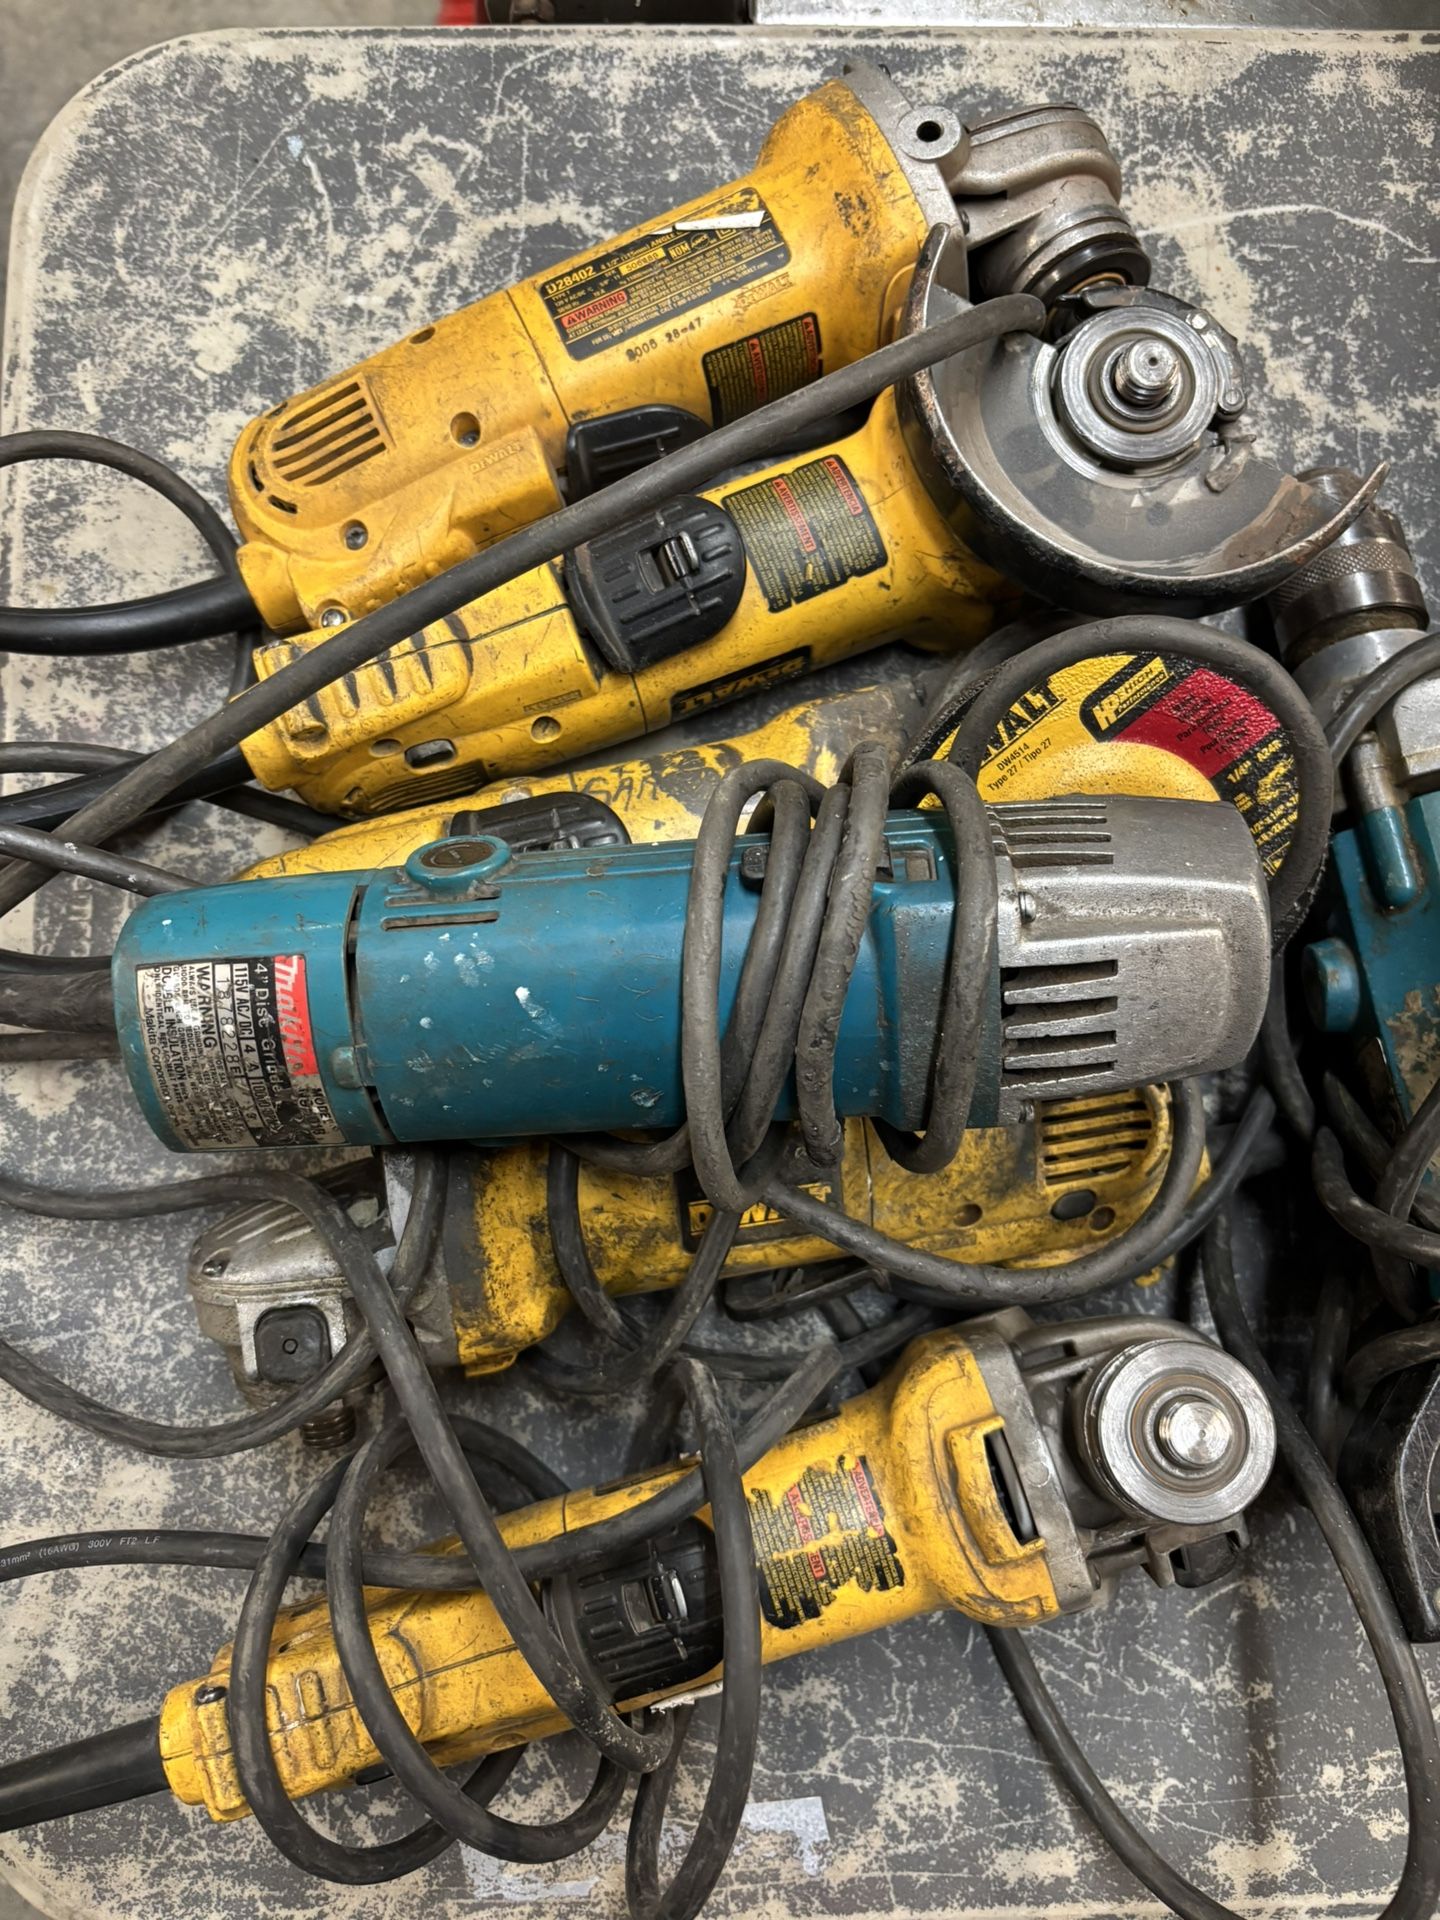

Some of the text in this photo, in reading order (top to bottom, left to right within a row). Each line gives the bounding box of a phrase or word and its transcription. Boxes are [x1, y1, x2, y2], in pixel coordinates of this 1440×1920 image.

[668, 241, 690, 259] NOM
[544, 264, 596, 295] D28402
[575, 291, 625, 322] WARNING
[829, 463, 861, 514] ADVERTENCIA
[778, 485, 815, 550] AVERTISSEMENT
[987, 772, 1009, 793] Type
[1006, 764, 1019, 776] 27
[1022, 745, 1043, 765] Tipo
[1040, 737, 1053, 749] 27
[996, 742, 1030, 771] DW4514
[193, 965, 221, 1048] WARNING
[233, 966, 254, 1035] 115V AC/DC
[253, 987, 273, 1028] Disc
[270, 955, 313, 1073] makita
[143, 1007, 157, 1044] Makita
[244, 1043, 259, 1072] 4 A
[88, 1538, 112, 1549] 300V
